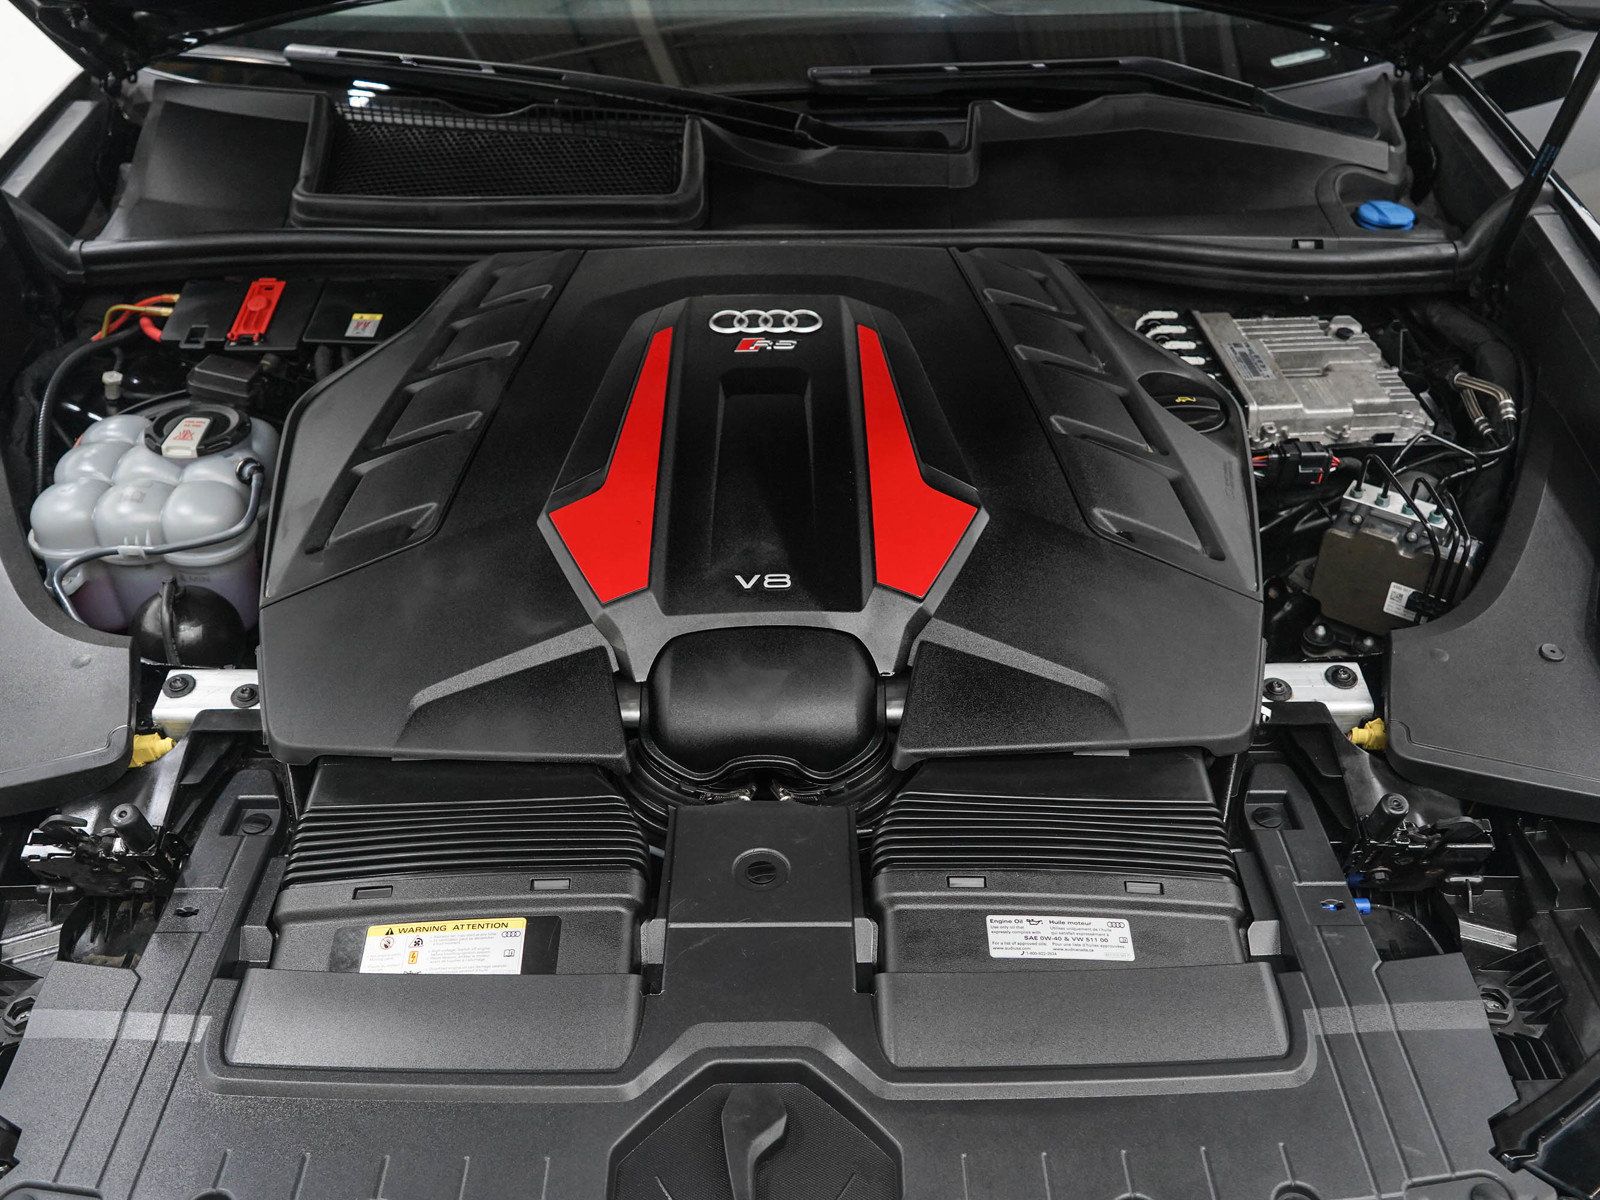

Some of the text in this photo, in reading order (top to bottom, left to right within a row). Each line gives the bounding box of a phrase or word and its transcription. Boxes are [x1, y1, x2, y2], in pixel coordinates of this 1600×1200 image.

[741, 338, 797, 351] RS
[734, 573, 792, 589] V8
[398, 922, 509, 934] WARNING ATTENTION
